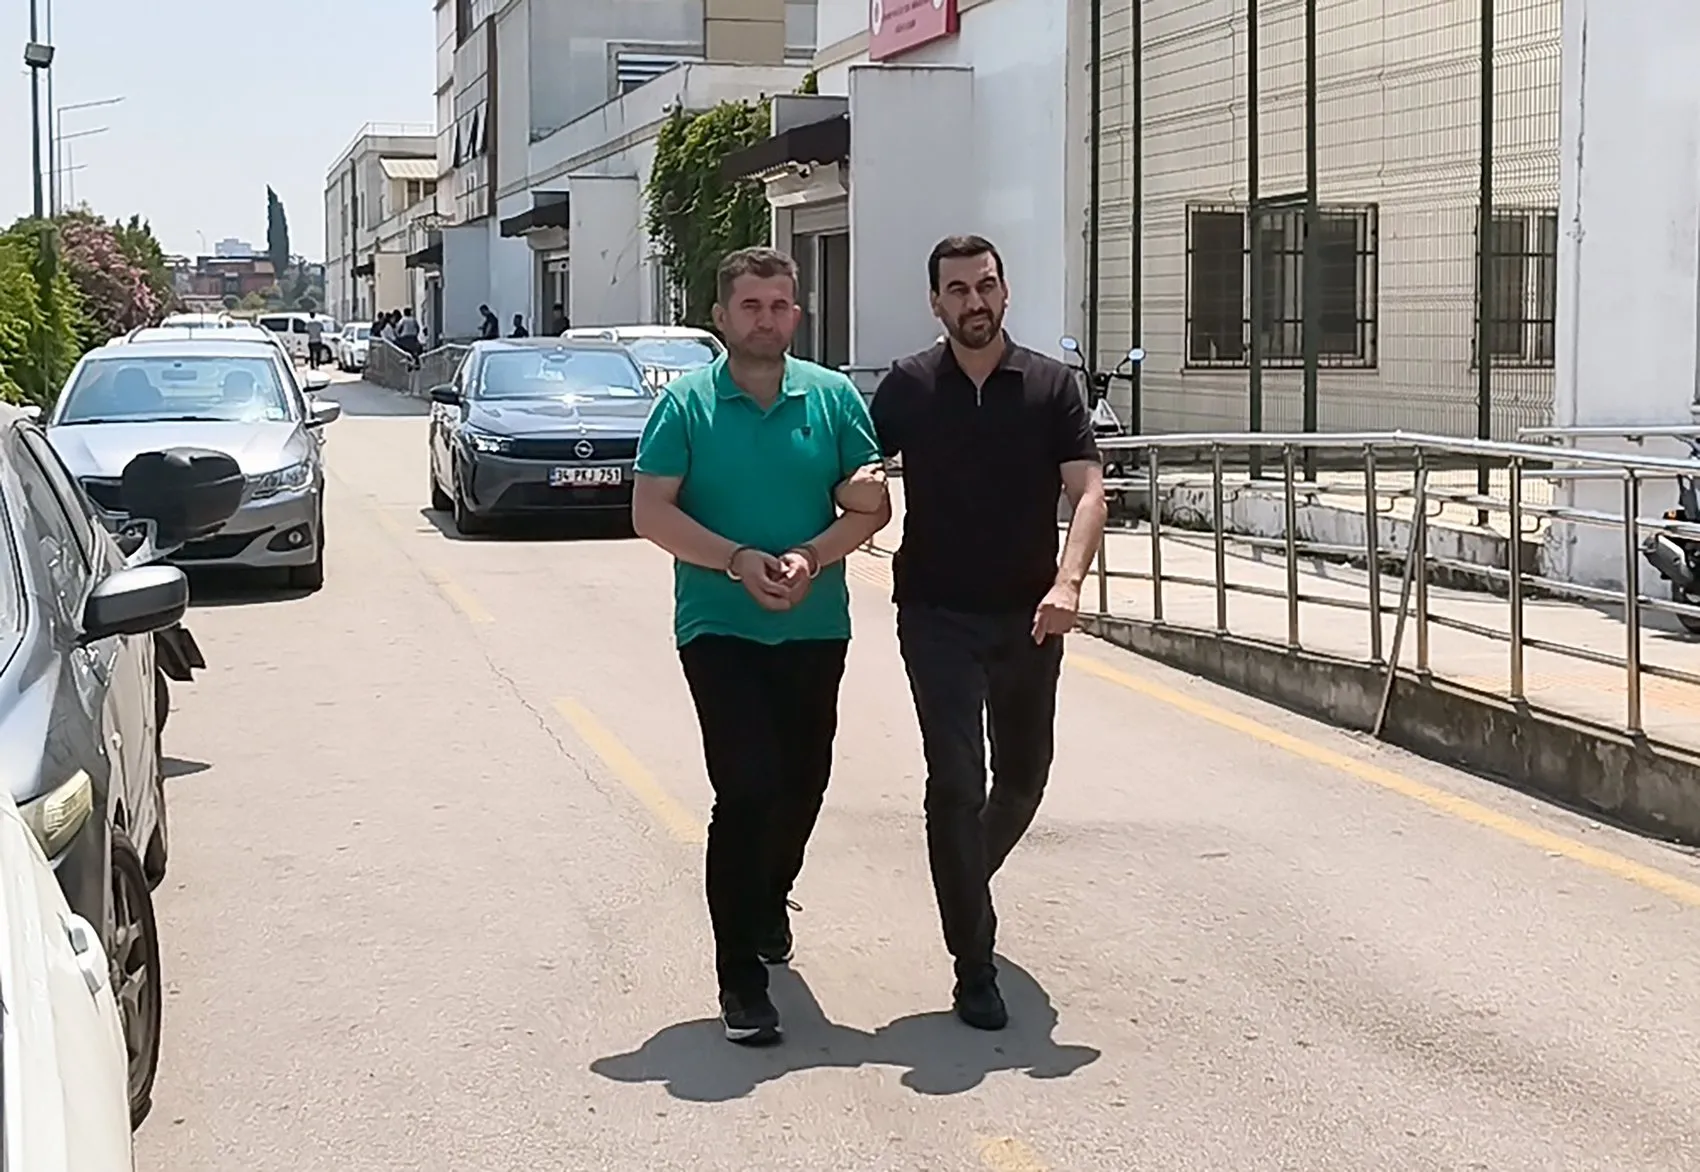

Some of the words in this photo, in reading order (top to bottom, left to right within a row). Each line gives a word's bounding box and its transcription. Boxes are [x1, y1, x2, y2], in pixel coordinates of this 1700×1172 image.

[556, 469, 569, 482] 34
[574, 469, 595, 482] PKJ
[600, 468, 620, 481] 751
